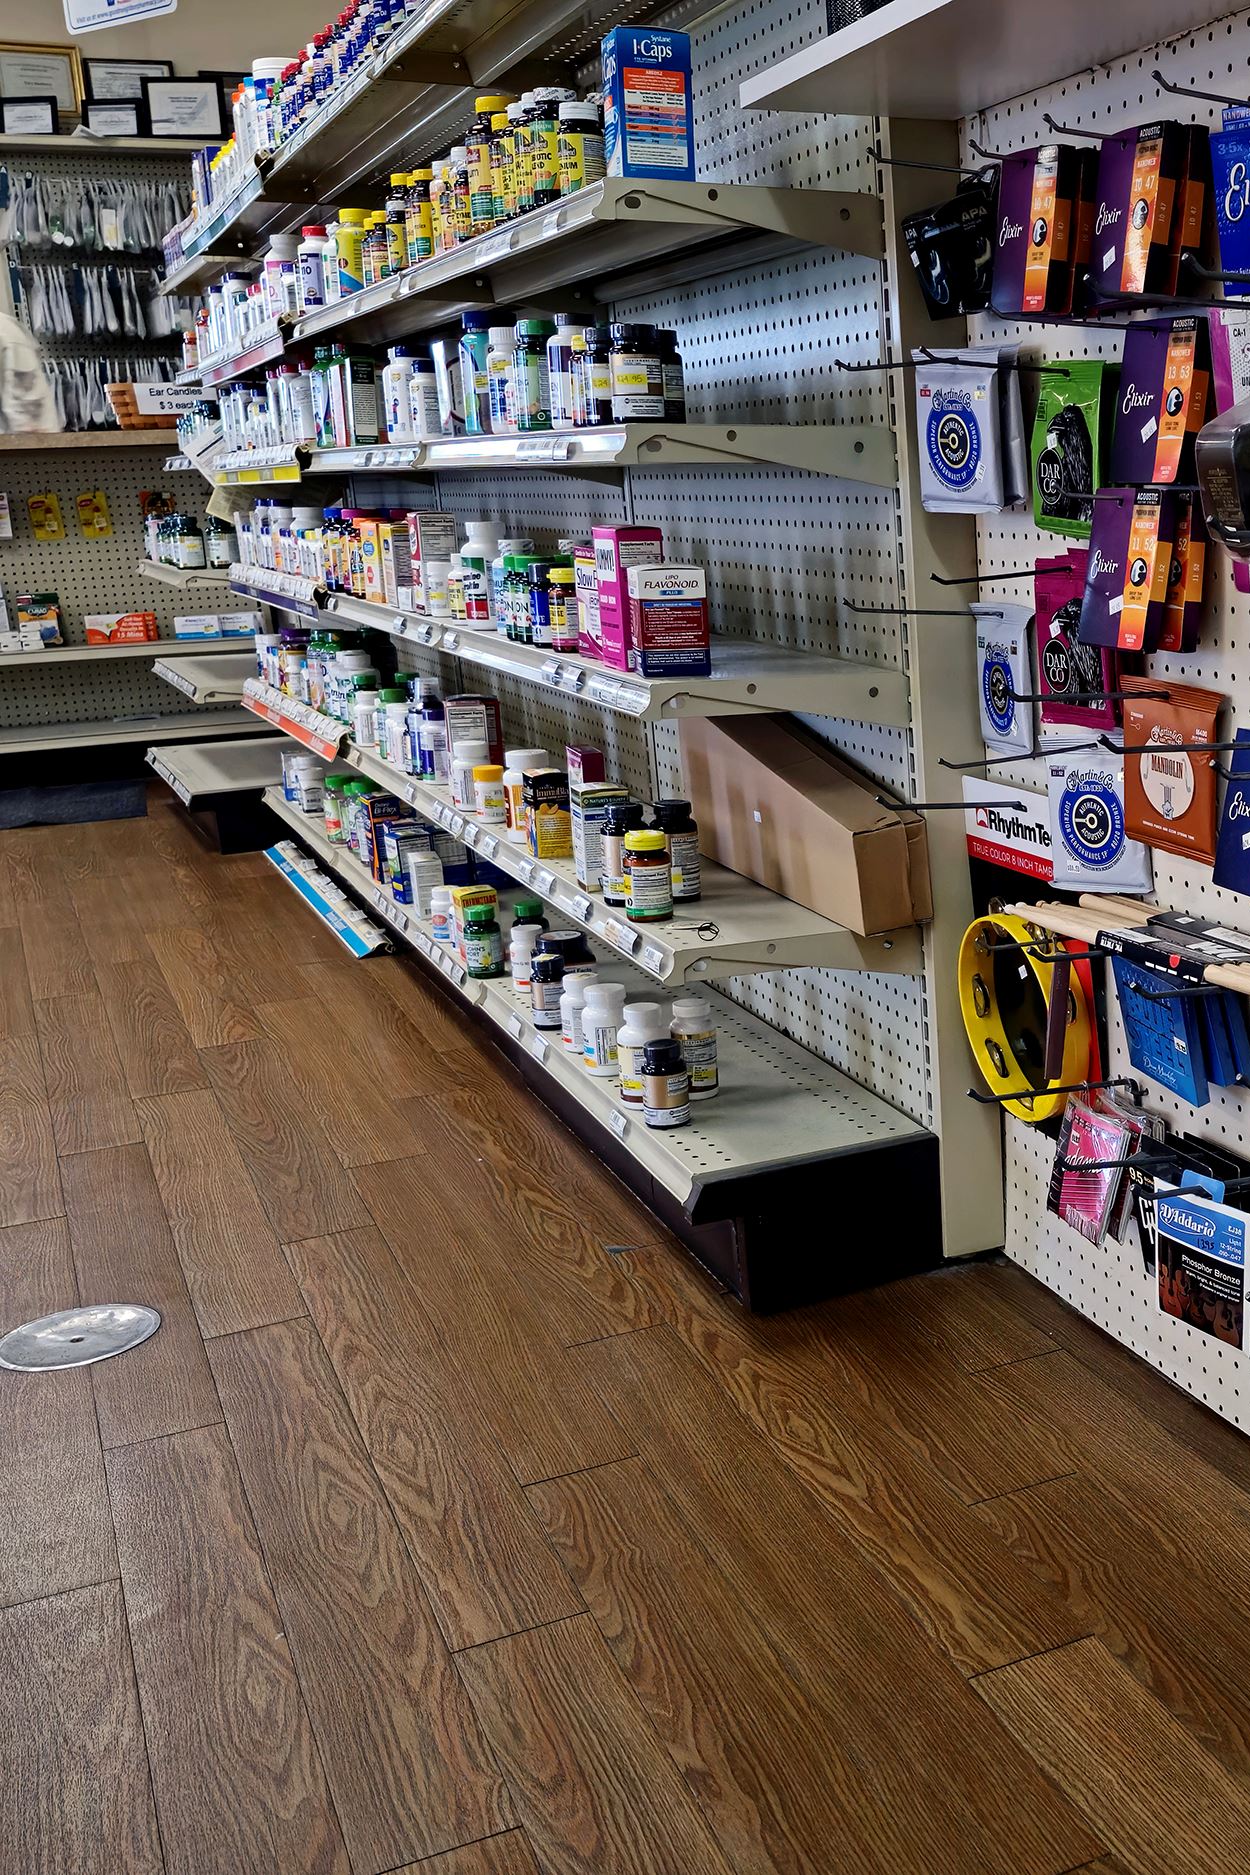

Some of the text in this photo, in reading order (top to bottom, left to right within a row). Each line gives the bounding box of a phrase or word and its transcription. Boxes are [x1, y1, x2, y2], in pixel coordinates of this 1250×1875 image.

[1139, 126, 1161, 138] ACOUSTIC
[1145, 175, 1155, 189] 47
[961, 206, 988, 222] APA
[1096, 202, 1122, 235] Elixir
[905, 228, 918, 240] APA
[1000, 216, 1024, 247] Elixir
[1173, 319, 1194, 328] ACOUSTIC
[1233, 328, 1246, 337] CA-1
[149, 387, 203, 396] Ear Candles
[1123, 384, 1154, 414] Elixir
[1040, 462, 1060, 480] DAR
[1133, 537, 1154, 550] 11 52
[1091, 550, 1118, 578] Elixir
[577, 568, 593, 589] Slow
[644, 581, 699, 589] FLAVONOID
[1046, 652, 1067, 669] DAR
[1050, 667, 1065, 683] CO
[1151, 754, 1183, 779] MANDOLIN
[1079, 802, 1104, 816] AUTHENTIC
[1111, 803, 1120, 828] BRONZE
[1081, 828, 1105, 840] ACOUSTIC
[1069, 834, 1101, 859] PERFORMANCE
[973, 841, 988, 856] TRUE
[989, 848, 1010, 863] COLOR
[1012, 856, 1016, 865] 8
[1018, 858, 1033, 870] INCH
[1129, 1168, 1144, 1184] 9.5
[1159, 1203, 1215, 1238] D'Addario
[1182, 1254, 1240, 1285] Phosphor Bronze
